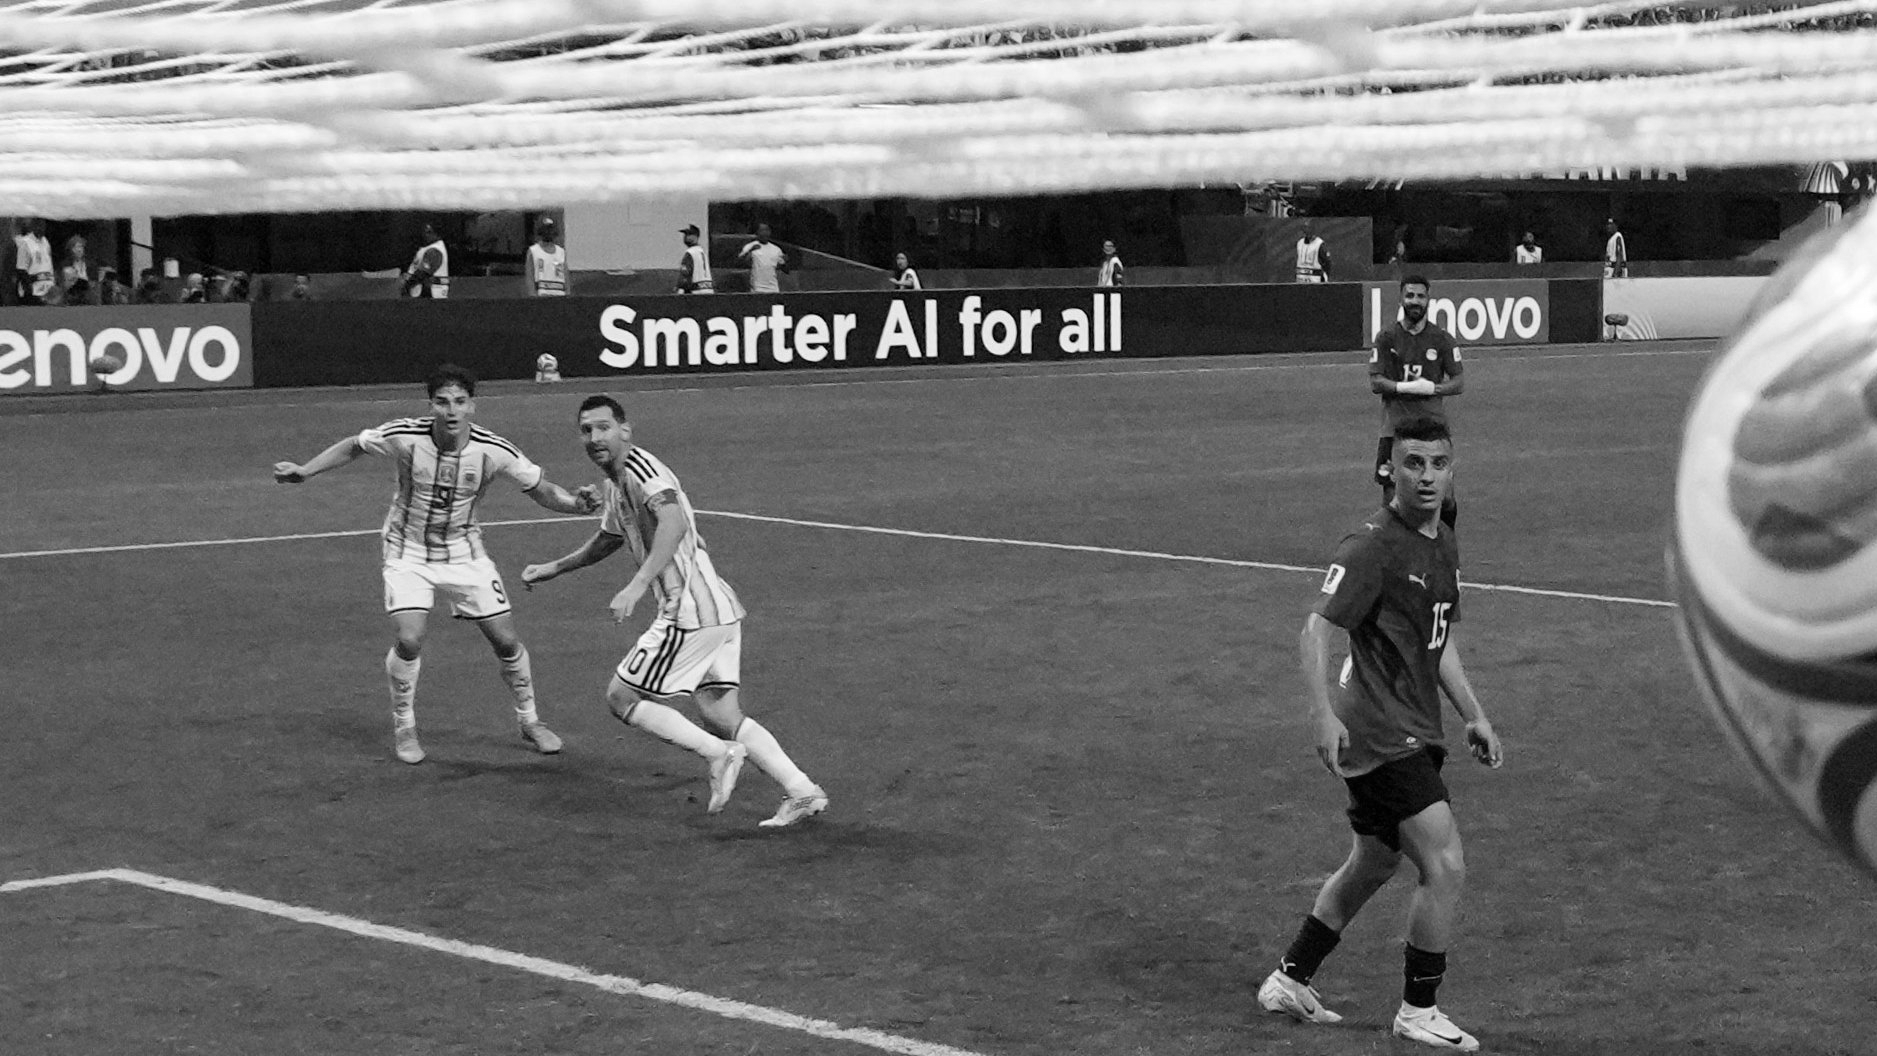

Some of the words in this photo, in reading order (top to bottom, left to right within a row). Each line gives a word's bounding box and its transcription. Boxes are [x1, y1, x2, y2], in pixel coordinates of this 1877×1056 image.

[599, 304, 857, 369] Smarter
[875, 299, 938, 360] AI
[959, 296, 1042, 357] for
[1059, 293, 1122, 354] all
[1371, 287, 1542, 343] Lnovo
[491, 579, 506, 604] 9
[1427, 602, 1453, 650] 15
